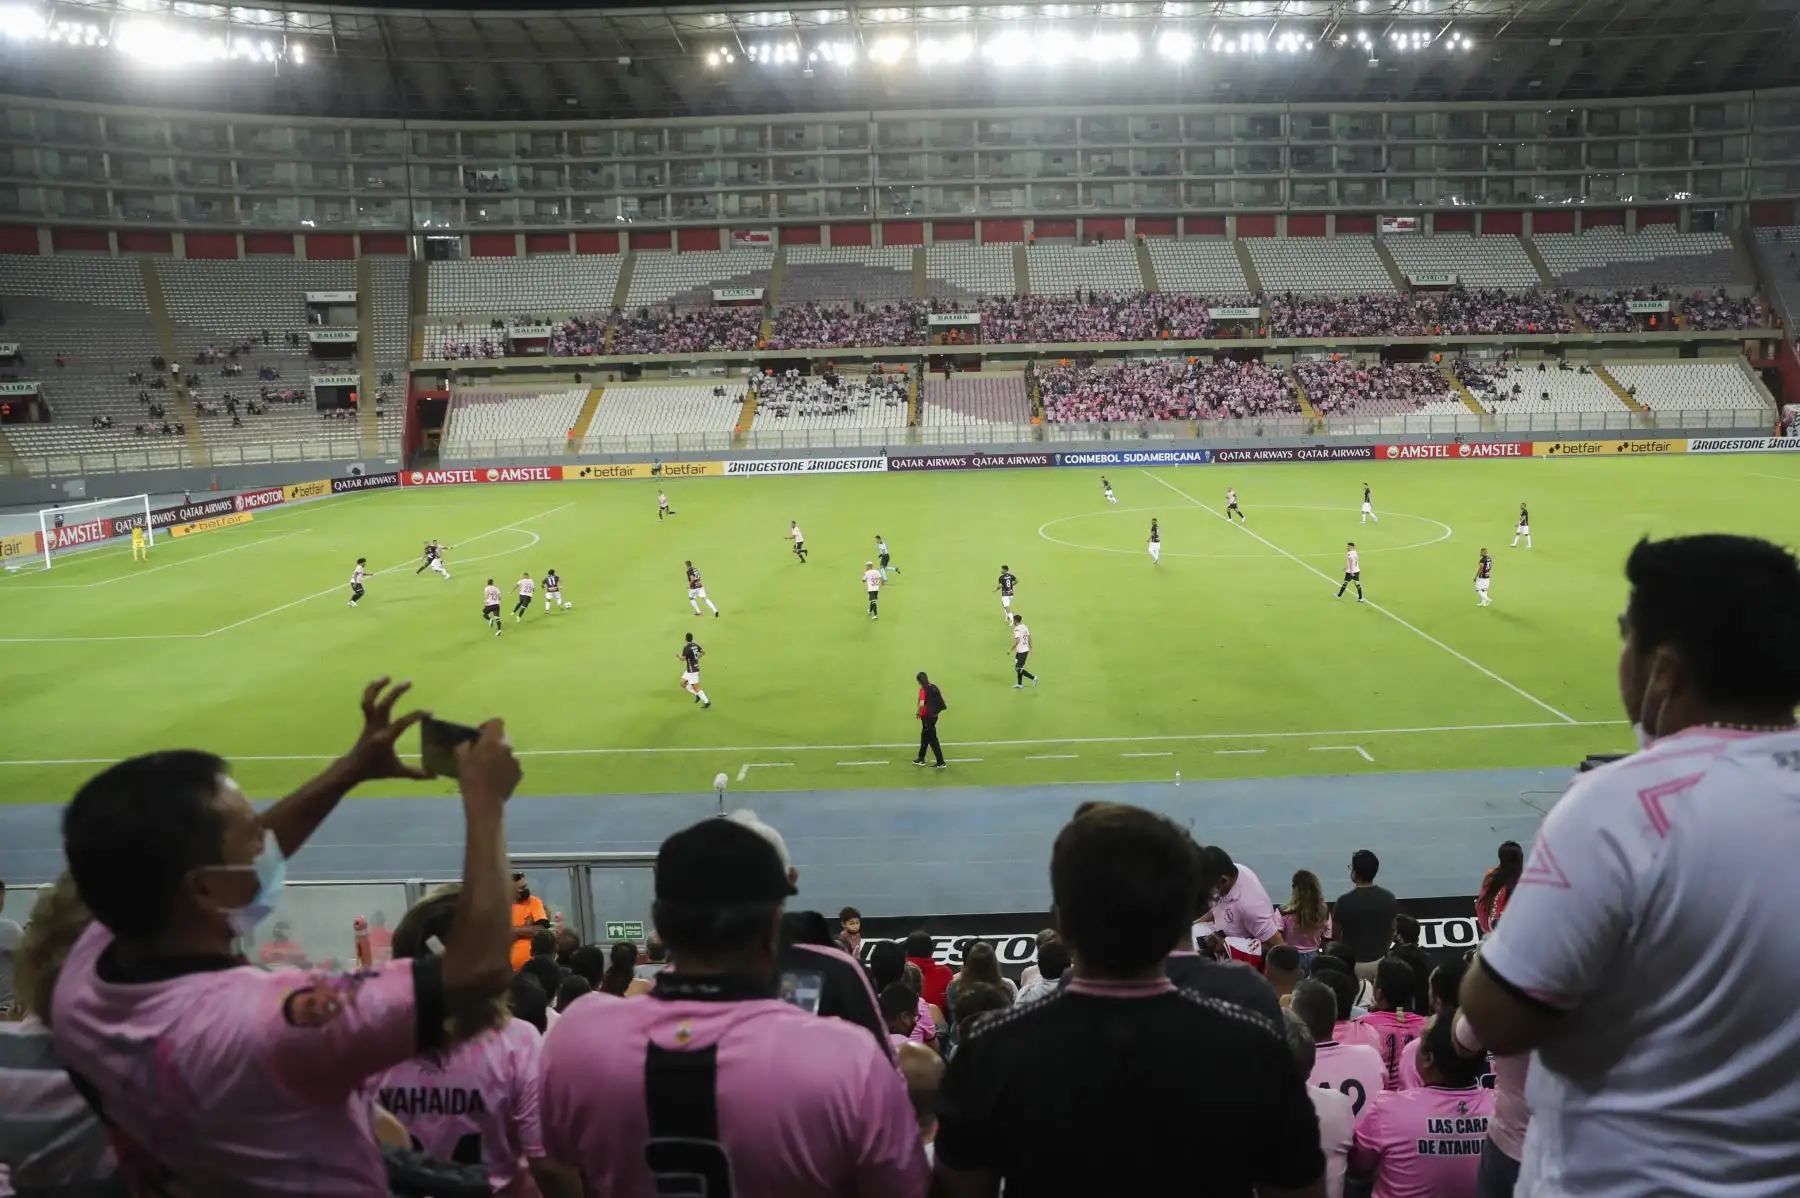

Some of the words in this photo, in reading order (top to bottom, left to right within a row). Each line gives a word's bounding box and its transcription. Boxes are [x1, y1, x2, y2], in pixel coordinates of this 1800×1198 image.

[1400, 444, 1449, 458] AMSTEL
[1472, 443, 1521, 456] AMSTEL
[1563, 441, 1603, 454] betfair
[1631, 440, 1672, 452] betfair
[1692, 439, 1765, 450] BRIDGESTONE
[891, 459, 923, 469] QATAR
[926, 457, 967, 467] AIRWAYS
[972, 457, 1005, 466] QATAR
[1007, 455, 1047, 465] AIRWAYS
[1064, 453, 1121, 464] CONMEBOL
[1123, 451, 1201, 463] SUDAMERICANA
[1219, 451, 1251, 461] QATAR
[1253, 450, 1293, 459] AIRWAYS
[1297, 450, 1329, 459] QATAR
[1331, 448, 1371, 458] AIRWAYS
[593, 466, 636, 477] betfair
[665, 464, 707, 475] betfair
[728, 461, 804, 473] BRIDGESTONE
[807, 459, 883, 471] BRIDGESTONE
[334, 479, 362, 491] QATAR
[363, 474, 397, 486] AIRWAYS
[425, 470, 478, 484] AMSTEL
[500, 467, 551, 481] AMSTEL
[300, 482, 324, 497] betfair
[257, 490, 283, 505] MOTOR
[180, 504, 205, 520] QATAR
[205, 500, 233, 514] AIRWAYS
[199, 515, 244, 530] betfair
[59, 521, 106, 547] AMSTEL
[1428, 1119, 1453, 1134] LAS
[1418, 1140, 1436, 1154] DE
[1438, 1139, 1484, 1154] ATAHU
